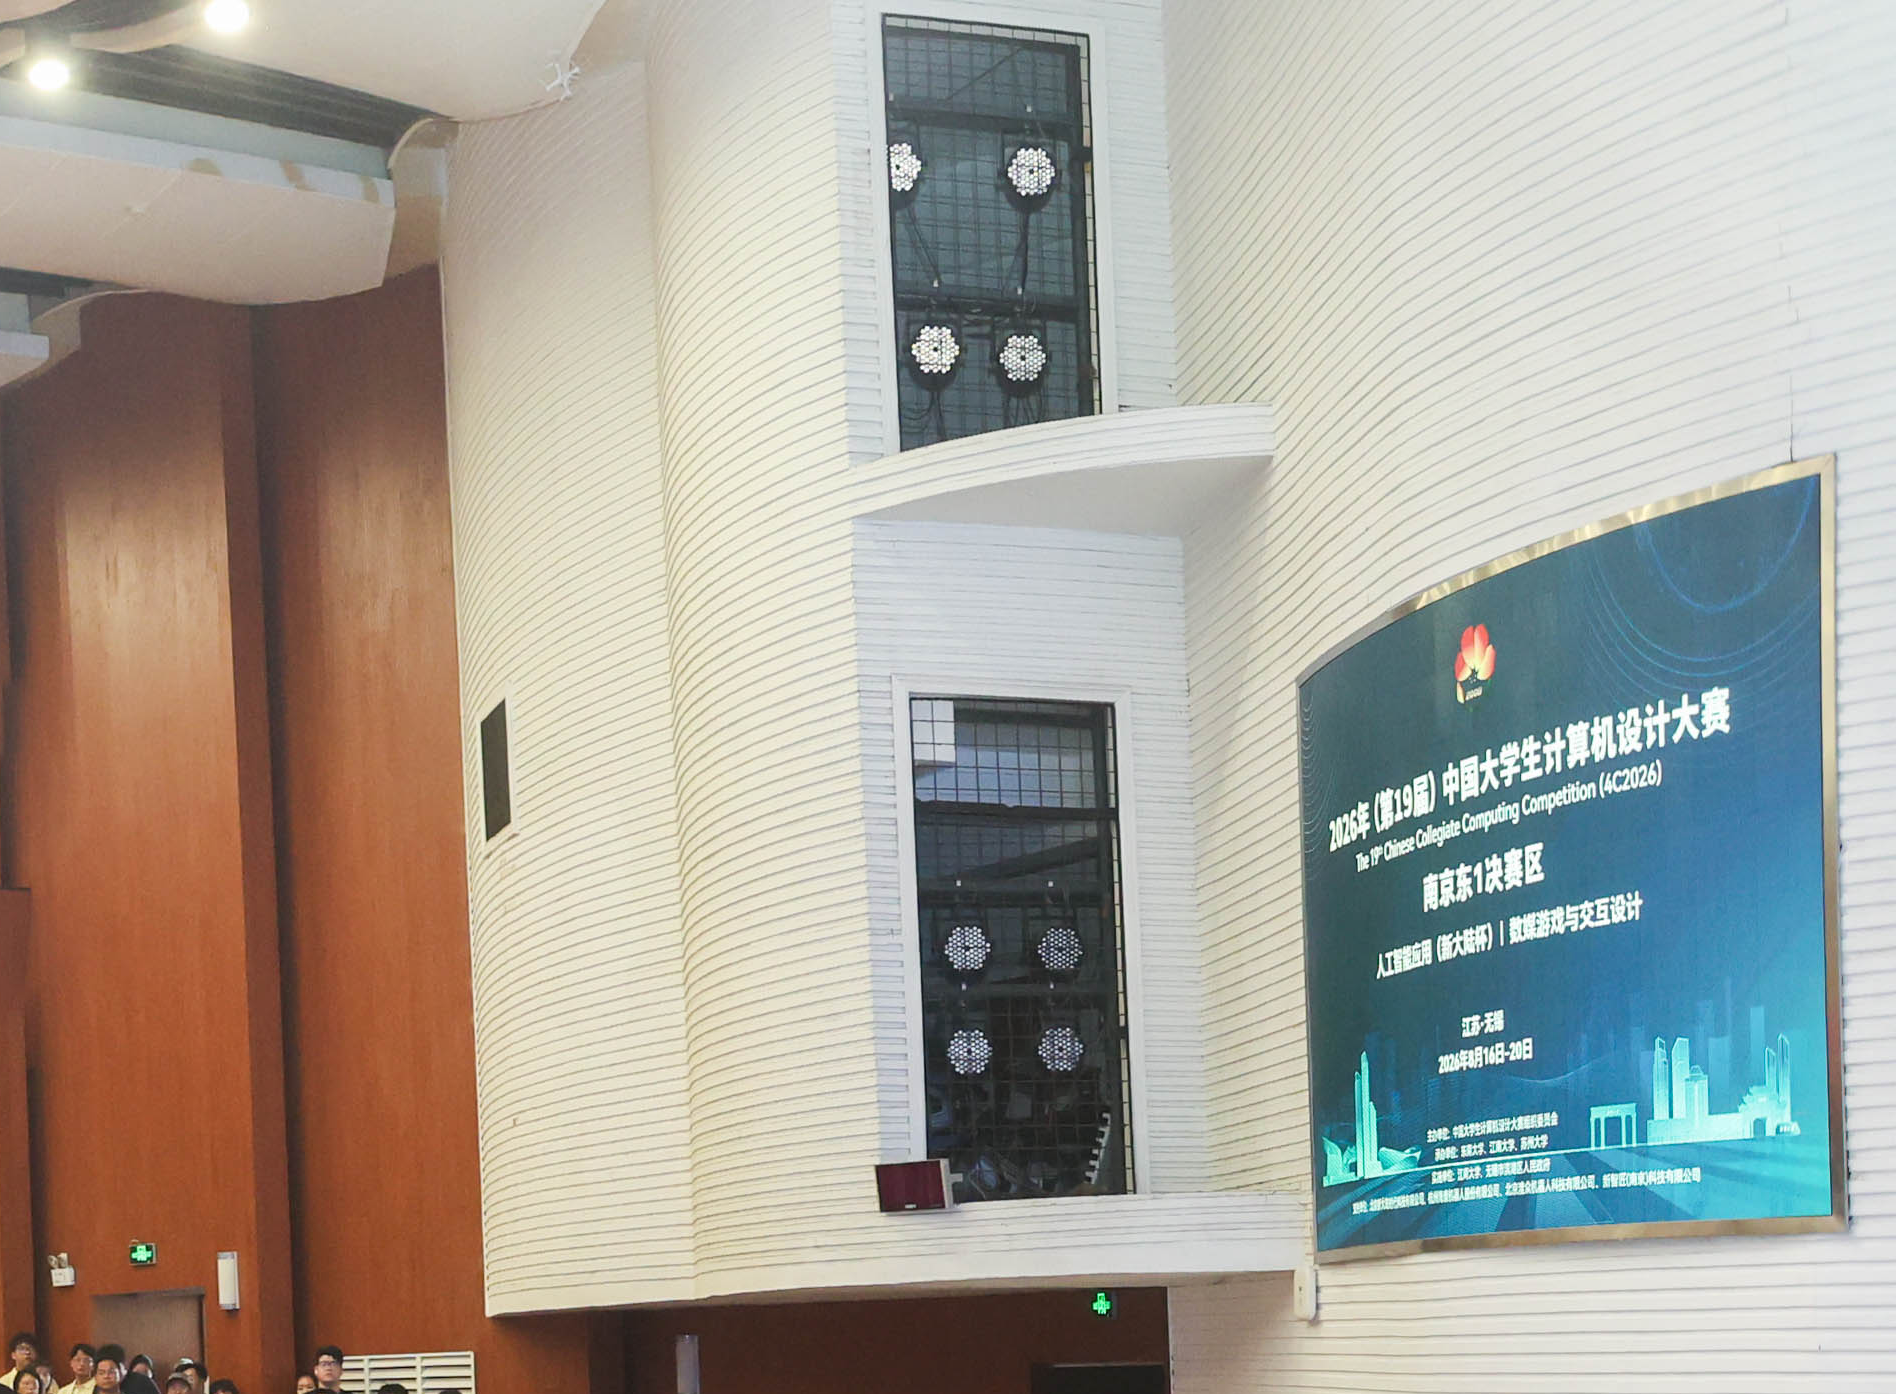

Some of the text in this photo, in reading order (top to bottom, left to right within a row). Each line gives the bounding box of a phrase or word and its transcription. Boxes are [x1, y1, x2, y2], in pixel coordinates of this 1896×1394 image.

[1355, 851, 1370, 873] The
[1383, 834, 1415, 862] Chinese
[1415, 820, 1461, 849] Collegiate
[1462, 801, 1520, 834] Computing
[1521, 780, 1596, 818] Competition
[1598, 758, 1663, 799] (4C2026)
[1422, 842, 1545, 912] 南京东1决赛区
